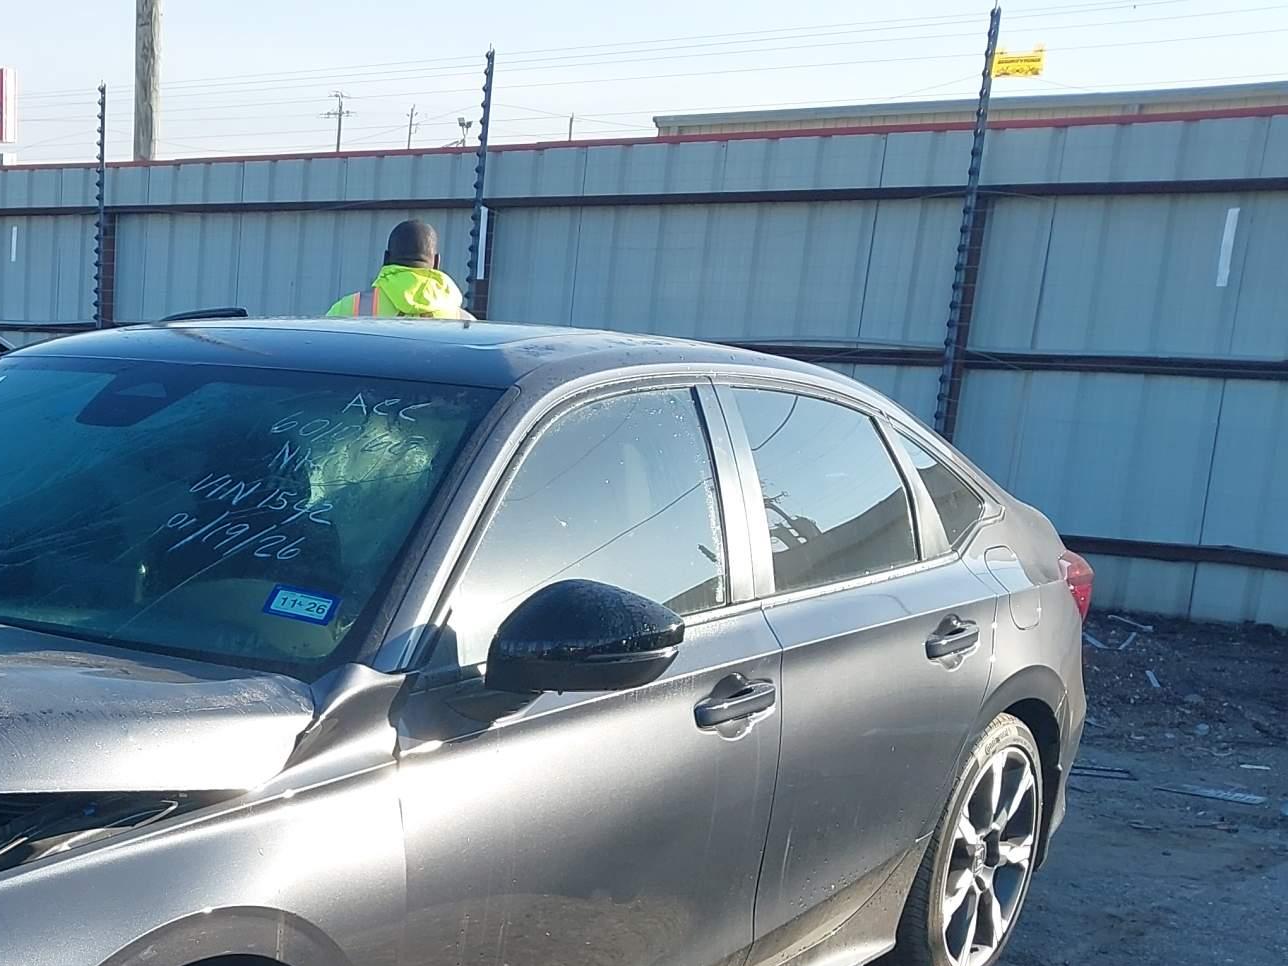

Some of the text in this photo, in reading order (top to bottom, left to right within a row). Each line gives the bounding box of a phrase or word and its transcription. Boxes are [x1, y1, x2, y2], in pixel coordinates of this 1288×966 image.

[189, 473, 262, 505] VIN
[167, 510, 306, 560] 01/19/26
[305, 601, 328, 615] 26
